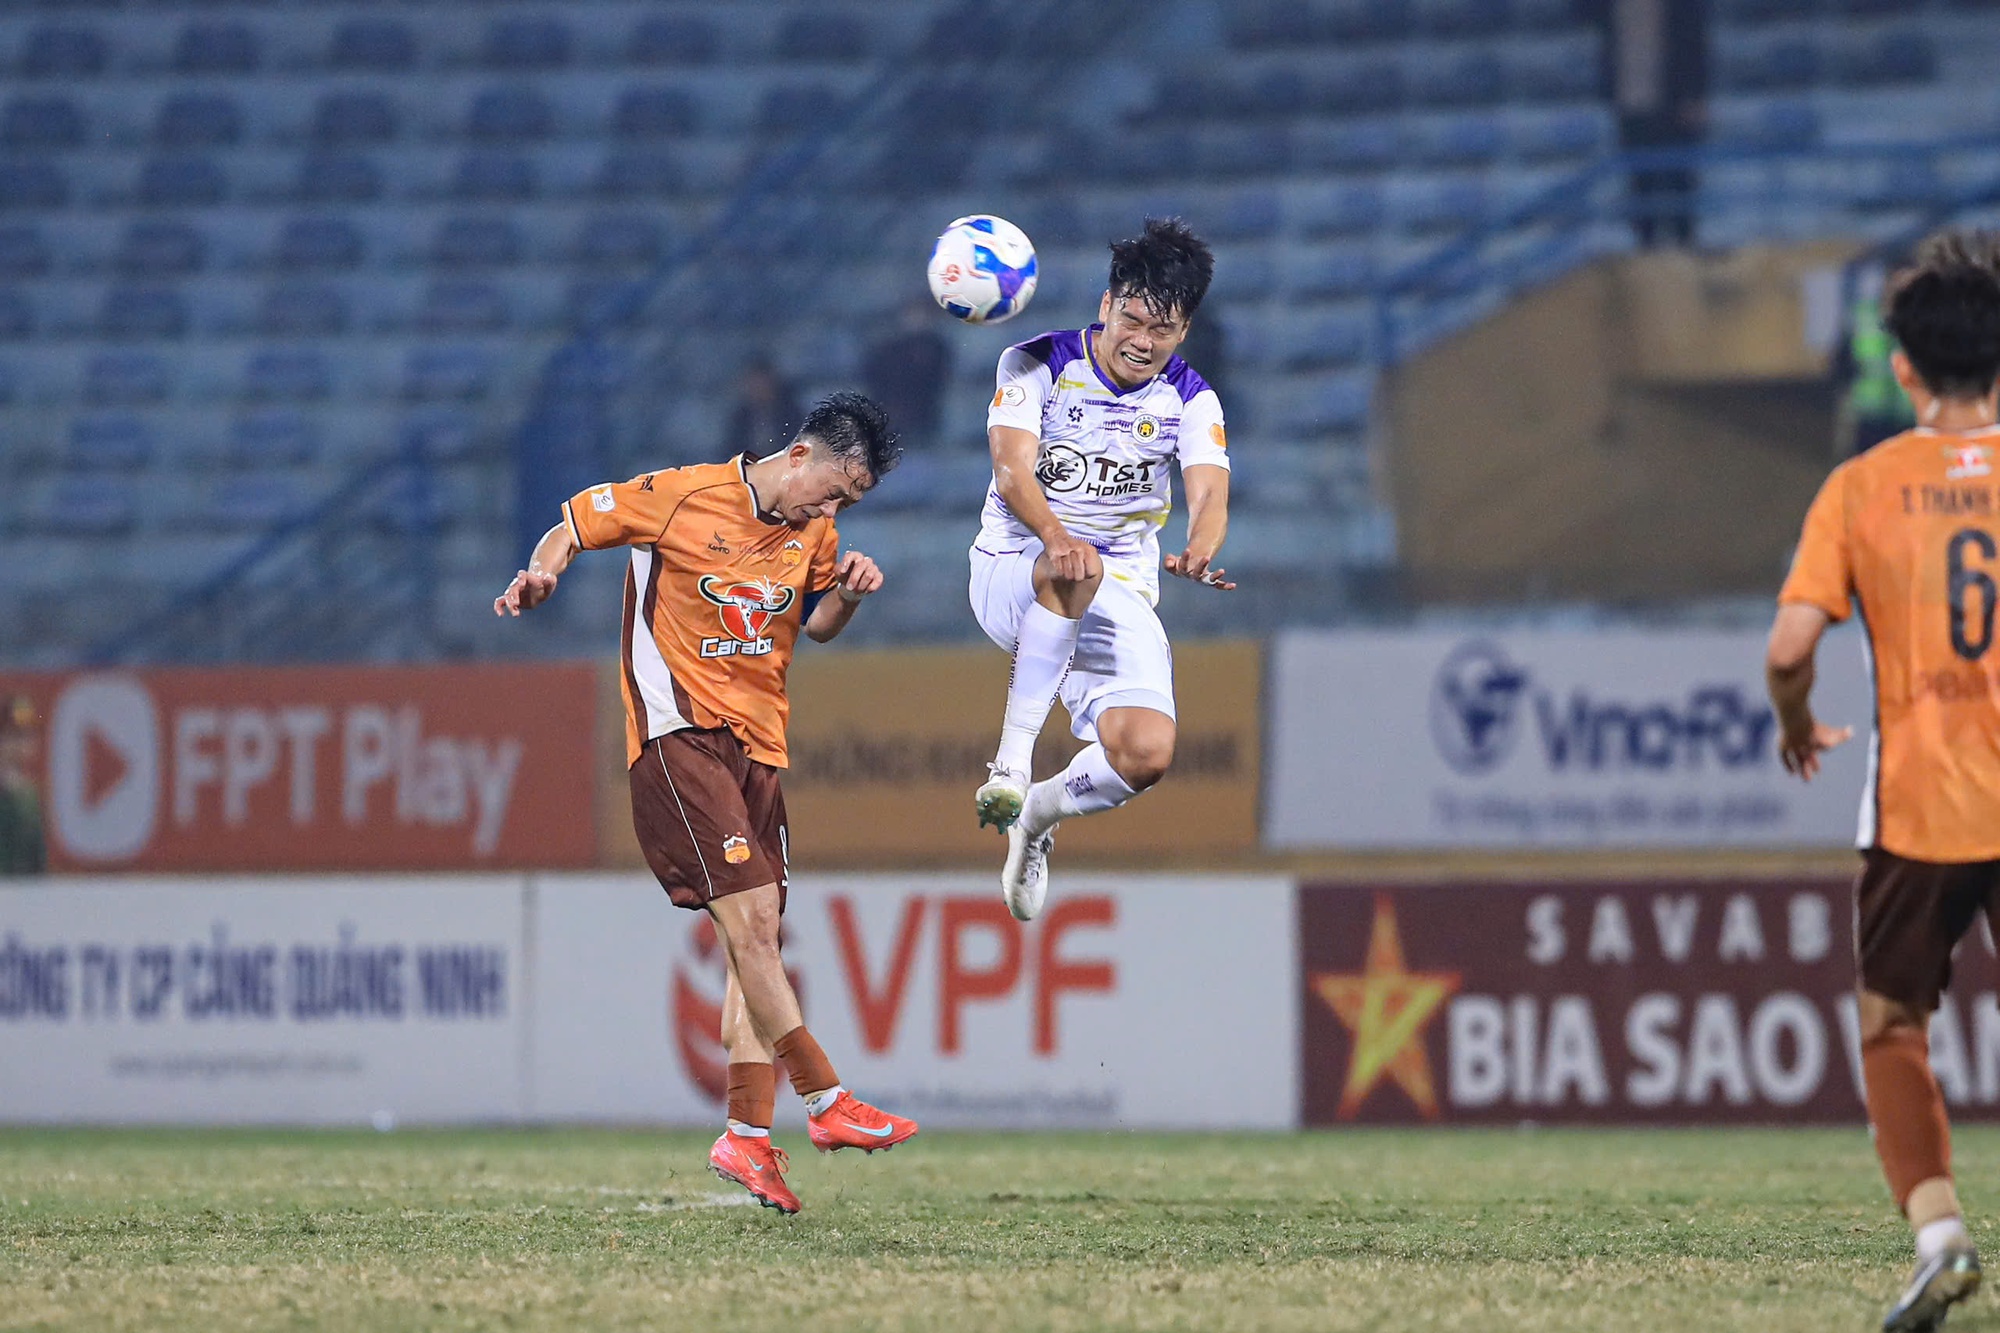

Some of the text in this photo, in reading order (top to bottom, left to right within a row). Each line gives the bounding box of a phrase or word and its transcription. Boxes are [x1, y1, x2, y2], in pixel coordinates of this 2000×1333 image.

[1086, 482, 1153, 496] HOMES
[1094, 457, 1156, 482] T&T
[701, 635, 773, 658] Carab
[1948, 528, 1997, 661] 6
[172, 703, 524, 856] FPT Play
[826, 892, 1118, 1056] VPF
[1446, 994, 1612, 1104] BIA
[1624, 990, 1830, 1105] SAO
